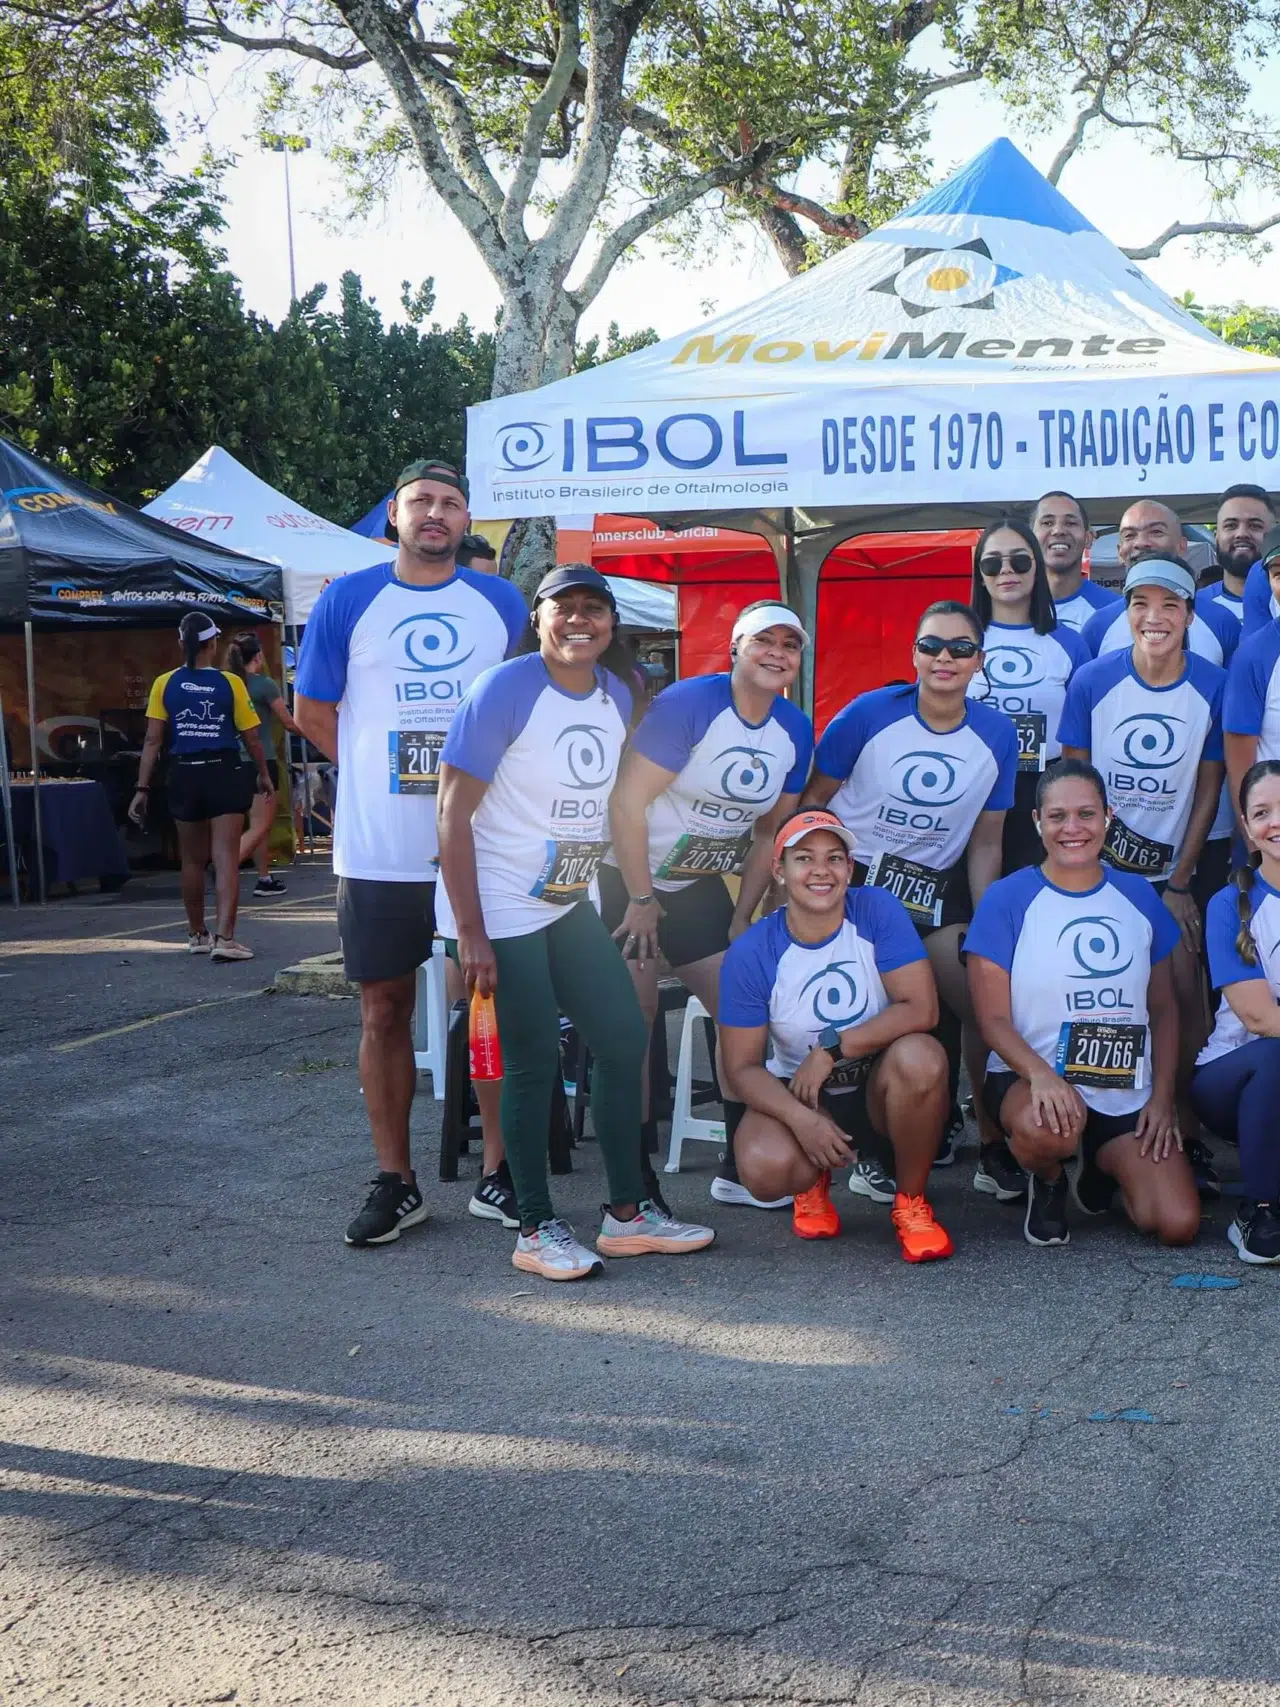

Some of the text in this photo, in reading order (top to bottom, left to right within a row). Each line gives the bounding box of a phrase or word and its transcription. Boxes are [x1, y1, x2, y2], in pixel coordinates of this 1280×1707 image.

[671, 331, 1166, 365] MoviMente
[562, 410, 788, 472] IBOL
[821, 415, 916, 475] DESDE
[929, 411, 1004, 470] 1970
[1038, 392, 1195, 481] TRADIÇÃO
[1208, 403, 1224, 461] E
[493, 481, 789, 502] Instituto Brasileiro de Oftalmologia
[972, 695, 1043, 714] BOL
[407, 747, 440, 774] 207
[1108, 771, 1178, 794] IBOL
[550, 799, 604, 819] IBOL
[692, 799, 754, 822] IBOL
[878, 805, 950, 832] IBOL
[680, 849, 736, 871] 20756
[1111, 830, 1160, 867] 20762
[538, 862, 551, 883] AZUL
[555, 857, 600, 885] 20745
[866, 863, 877, 886] ANCO
[882, 870, 936, 907] 20758
[1066, 988, 1134, 1012] IBOL
[1056, 1042, 1065, 1064] AZUL
[1075, 1038, 1133, 1068] 20766
